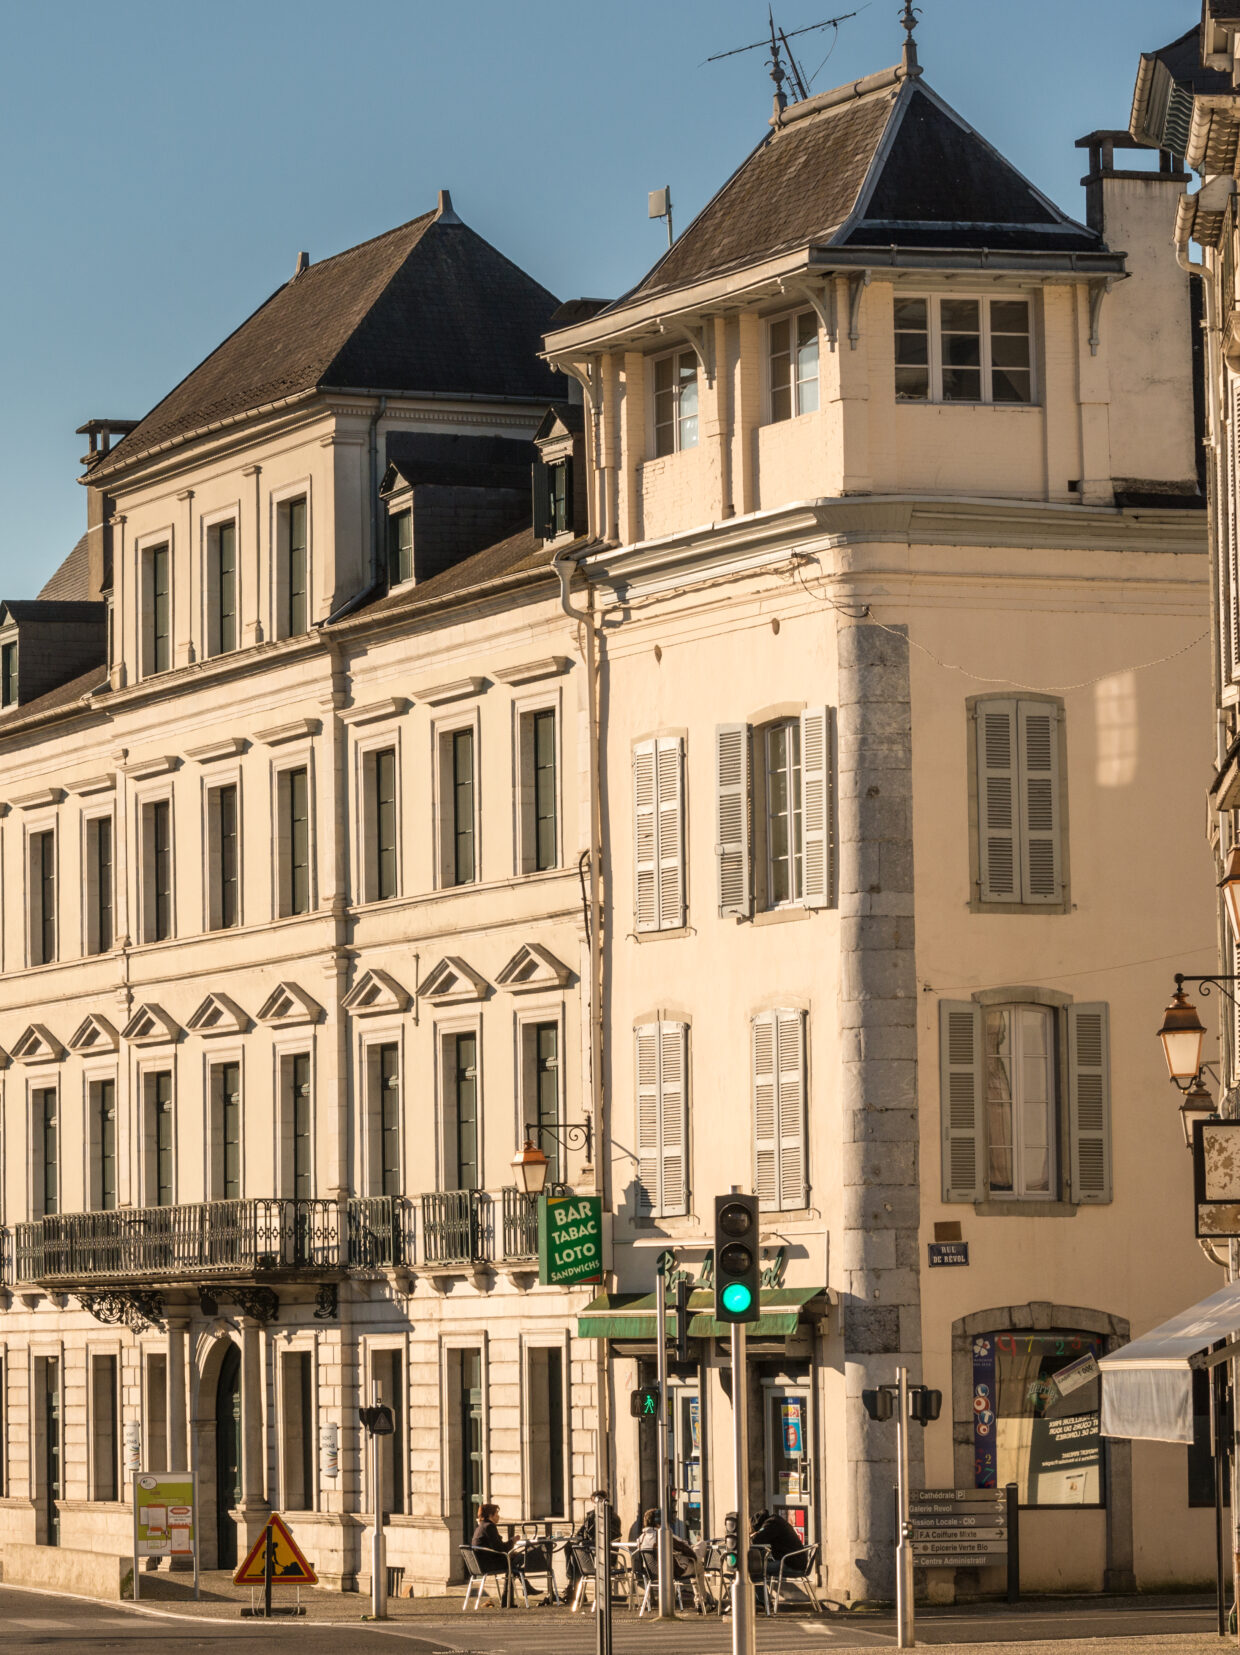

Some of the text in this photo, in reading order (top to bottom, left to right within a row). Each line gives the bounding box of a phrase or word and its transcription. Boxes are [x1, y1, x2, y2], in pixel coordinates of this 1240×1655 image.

[554, 1201, 592, 1226] BAR
[551, 1220, 597, 1245] TABAC
[554, 1243, 595, 1266] LOTO
[551, 1259, 600, 1282] SANDWICHS
[920, 1491, 955, 1499] Cathédrale
[909, 1505, 933, 1513] Galerie
